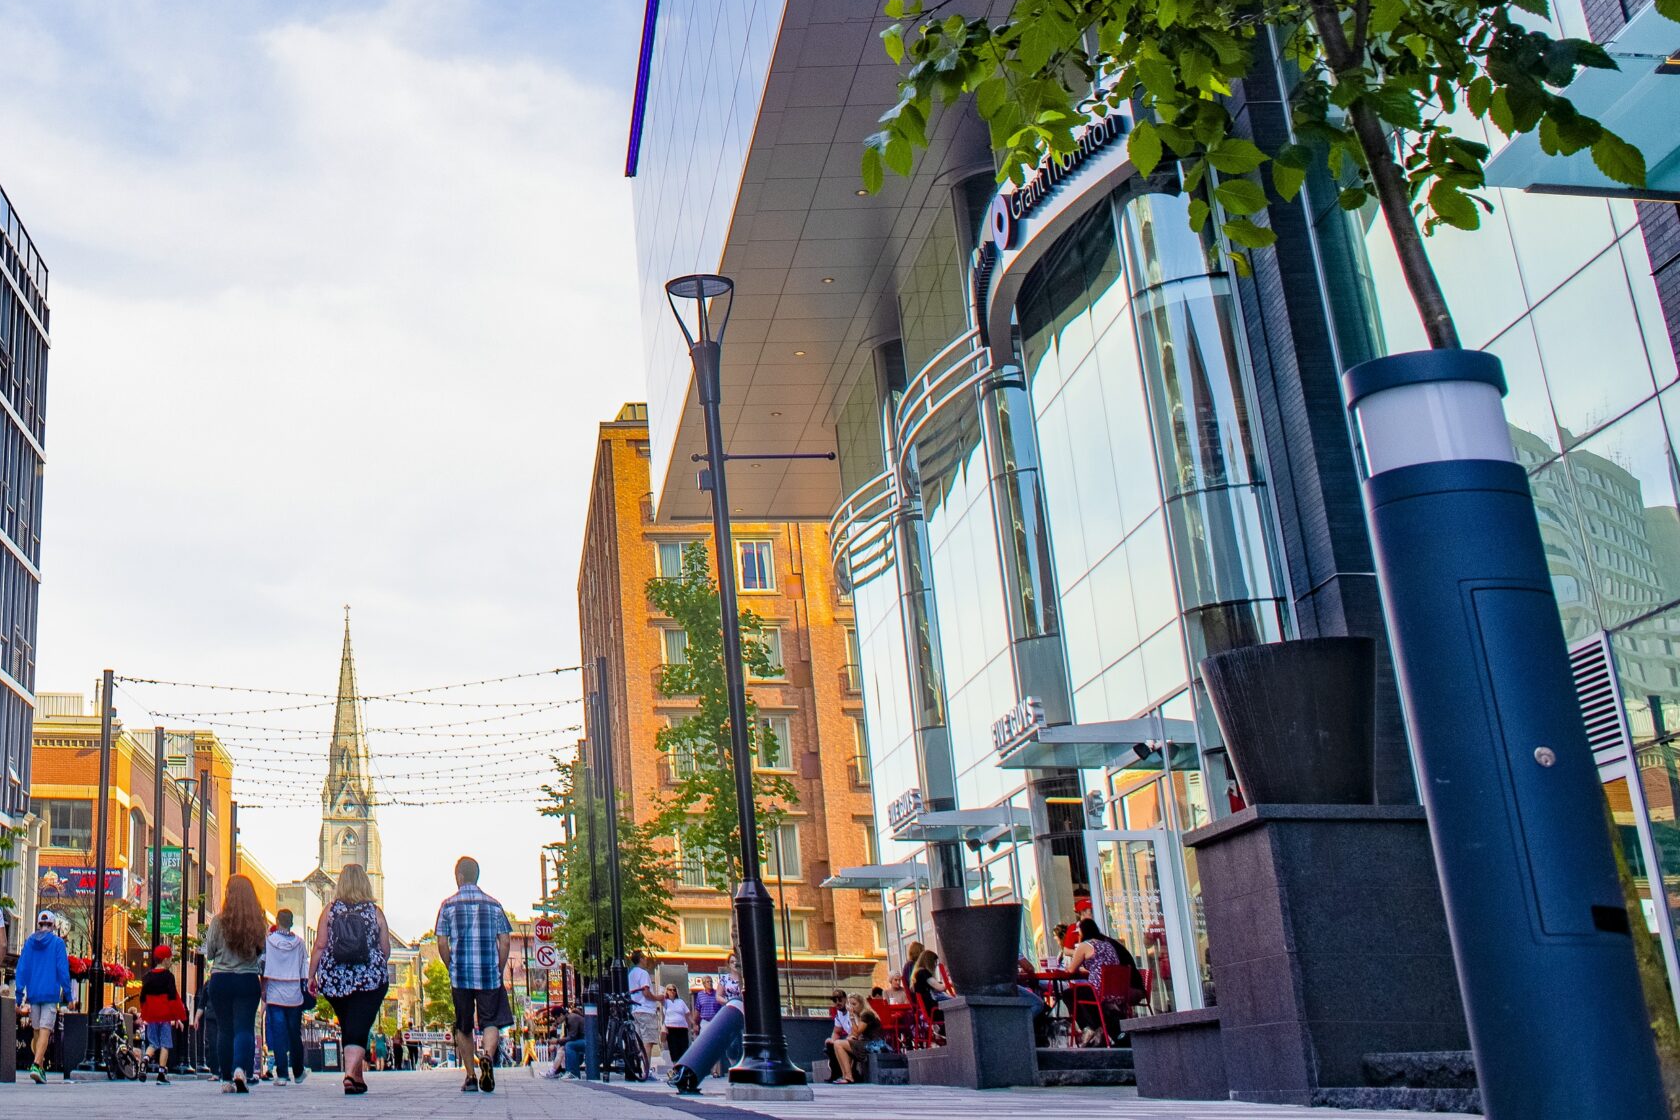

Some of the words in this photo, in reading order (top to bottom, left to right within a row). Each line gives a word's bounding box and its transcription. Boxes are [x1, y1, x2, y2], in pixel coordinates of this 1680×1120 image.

[1010, 169, 1047, 220] Grant
[991, 713, 1011, 751] FIVE
[1009, 696, 1038, 738] GUYS
[536, 925, 555, 936] STO
